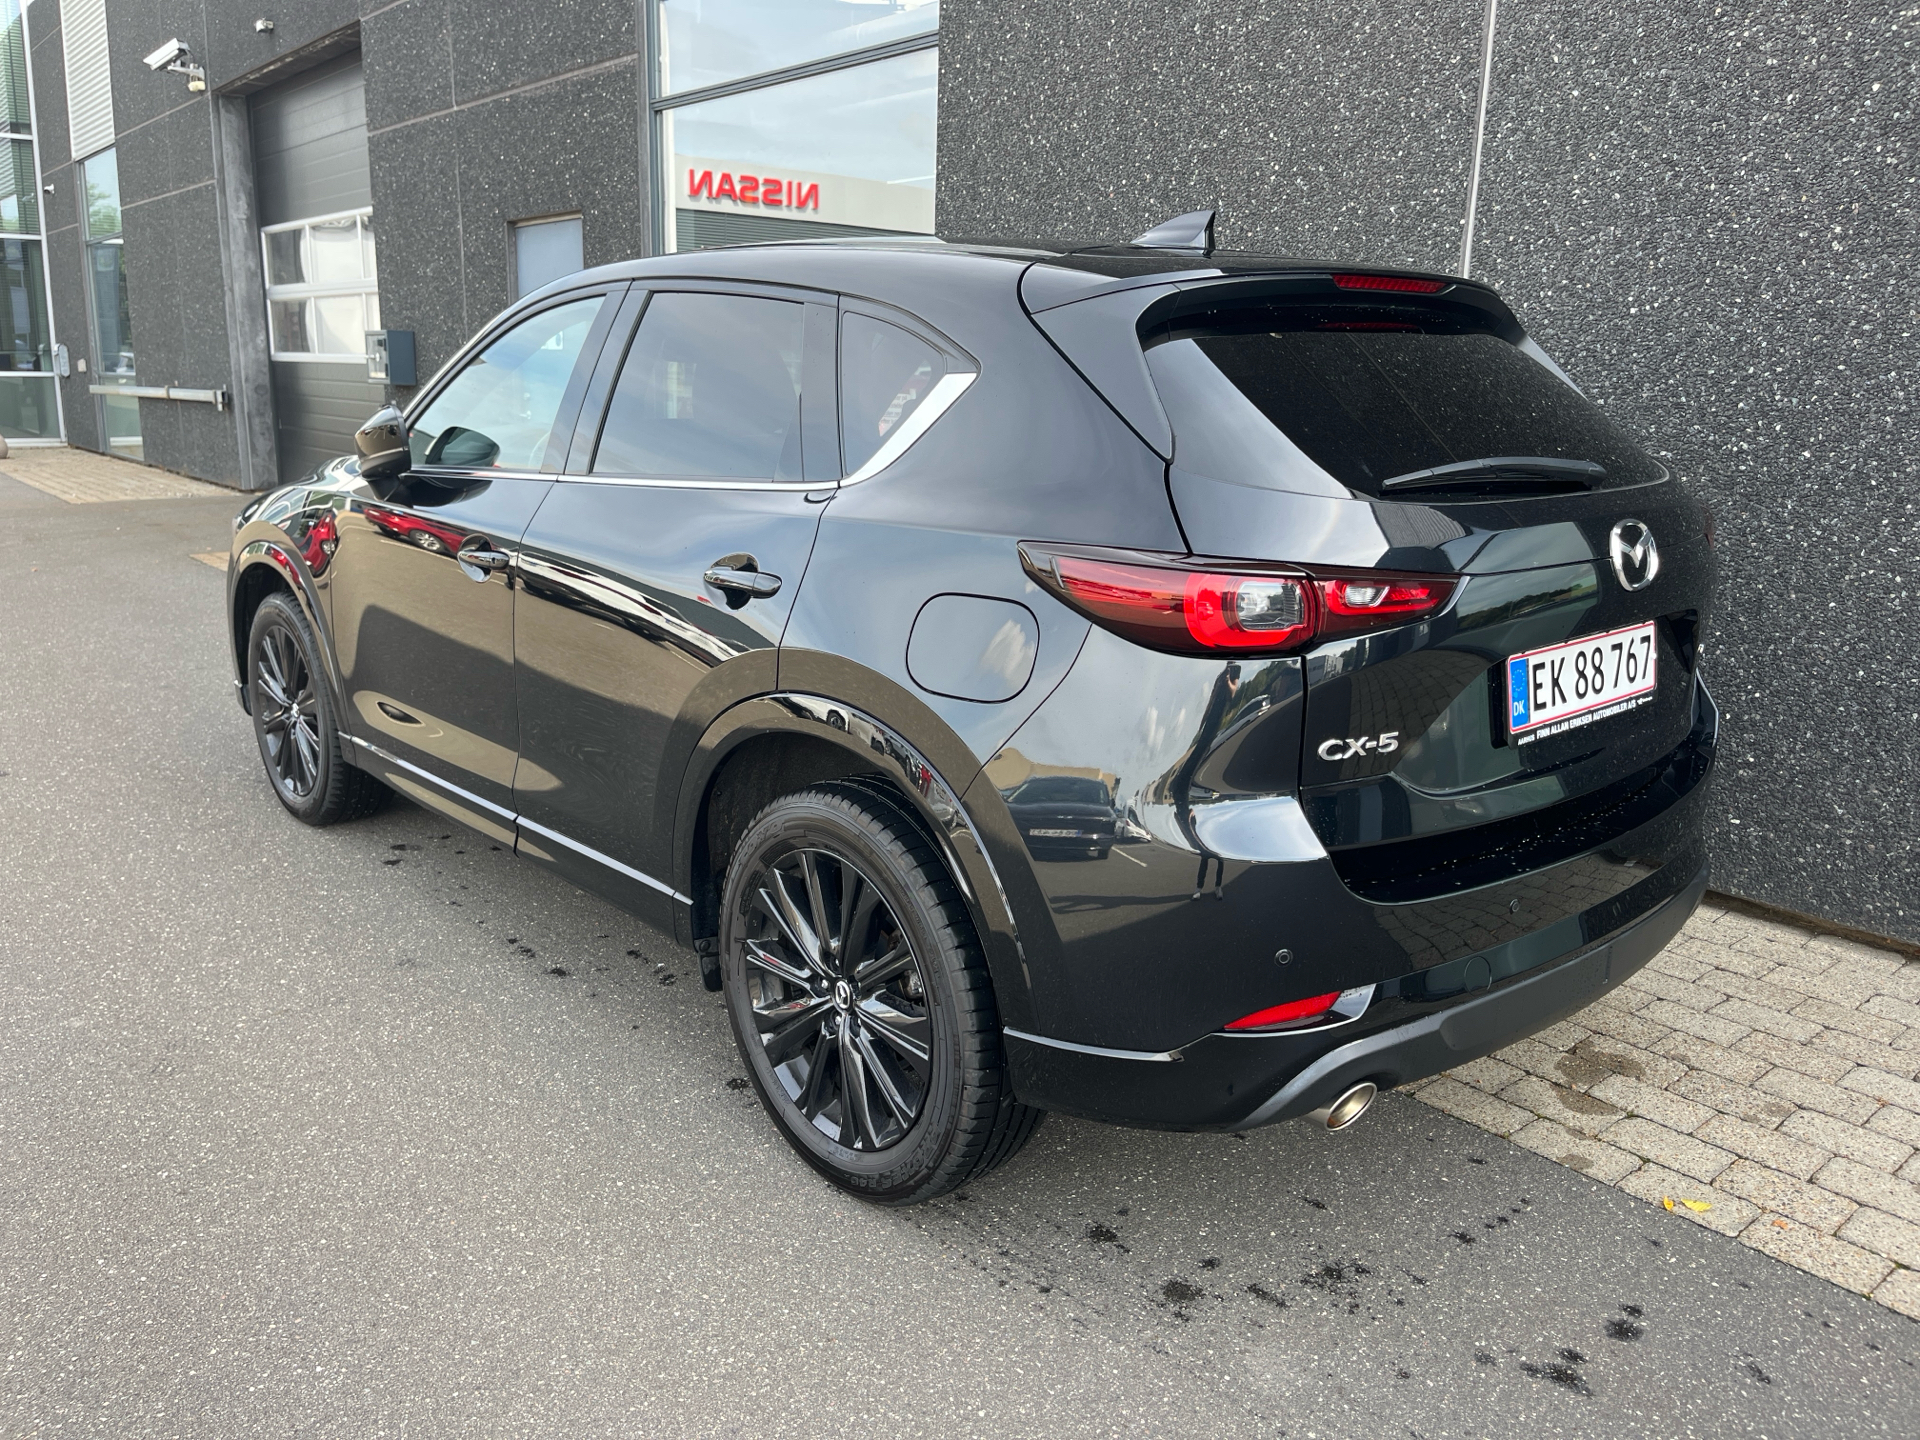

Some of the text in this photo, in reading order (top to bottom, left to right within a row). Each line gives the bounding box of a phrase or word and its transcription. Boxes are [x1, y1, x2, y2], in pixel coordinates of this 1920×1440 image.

[1532, 634, 1651, 711] EK 88 767
[1513, 700, 1526, 717] DK
[1536, 727, 1551, 740] FINN
[1550, 720, 1570, 735] ALLAN
[1569, 713, 1593, 729] ERIKSEN
[1593, 702, 1628, 721] AUTOMOBILER
[1317, 731, 1399, 761] CX-5
